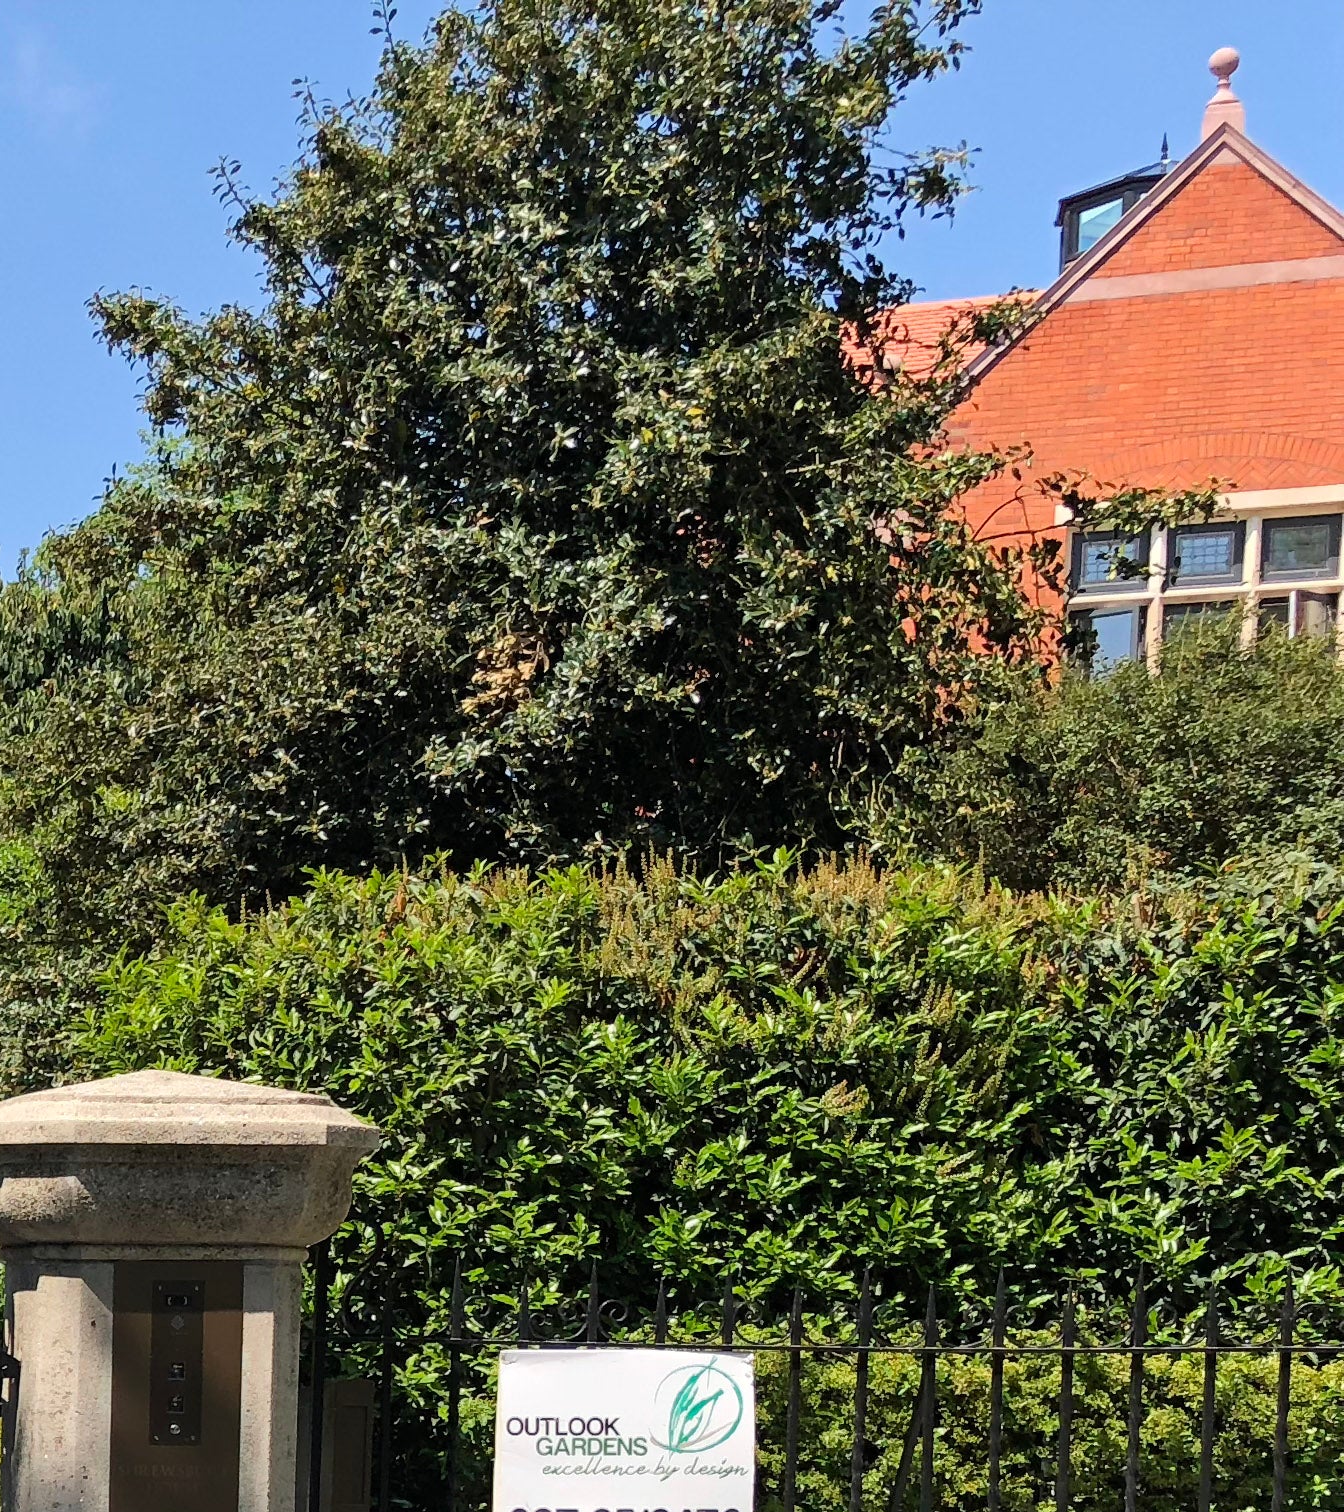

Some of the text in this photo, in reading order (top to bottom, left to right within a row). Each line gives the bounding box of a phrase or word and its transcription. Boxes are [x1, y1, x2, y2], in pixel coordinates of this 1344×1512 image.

[506, 1417, 620, 1436] OUTLOOK
[536, 1437, 648, 1456] GARDENS
[542, 1456, 749, 1482] excellence by design
